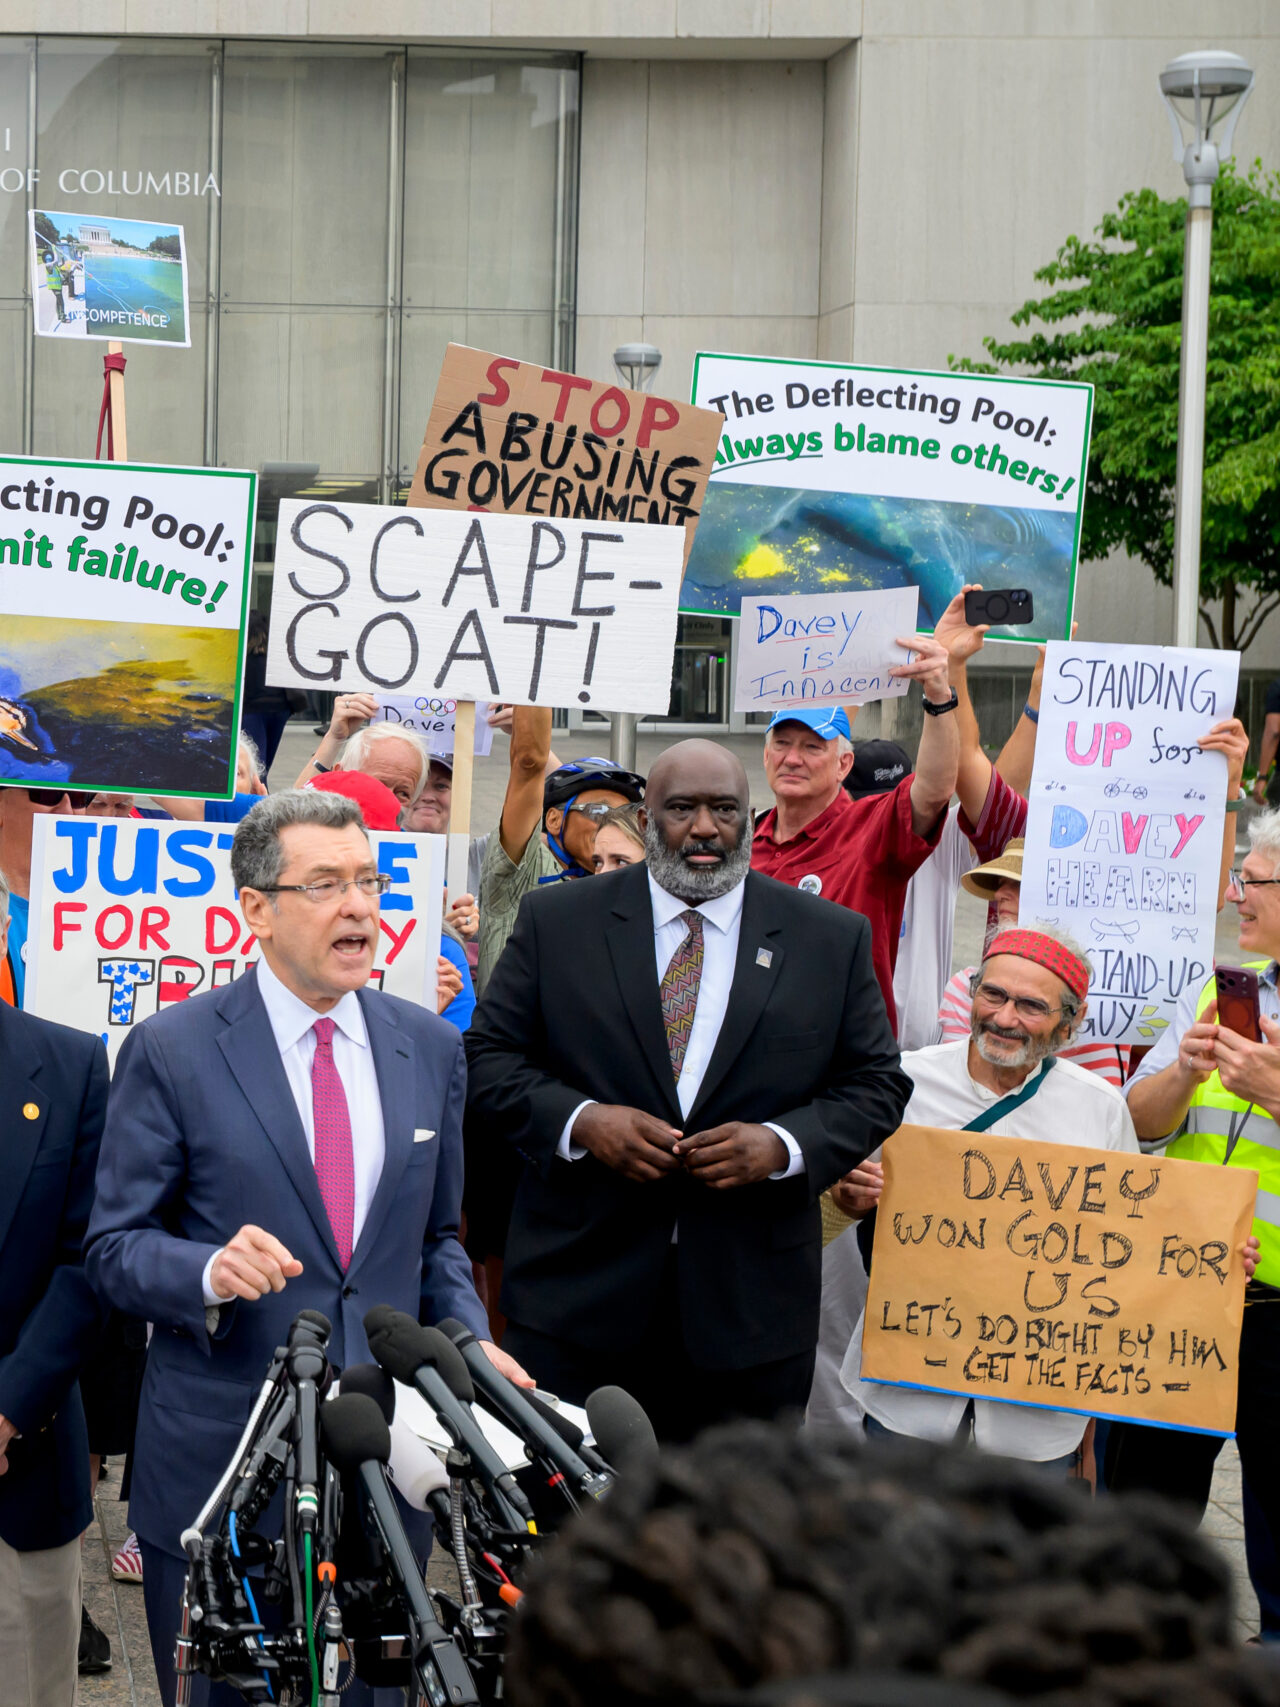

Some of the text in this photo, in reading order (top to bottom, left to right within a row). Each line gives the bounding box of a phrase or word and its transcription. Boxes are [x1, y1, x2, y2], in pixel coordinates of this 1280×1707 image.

[5, 127, 11, 151] I
[0, 168, 40, 193] OF
[58, 169, 221, 197] COLUMBIA
[477, 357, 680, 448] STOP
[708, 379, 1057, 447] The Deflecting Pool:
[834, 422, 941, 459] blame
[950, 443, 1076, 501] others!
[123, 496, 235, 564] Pool:
[67, 536, 229, 613] failure!
[288, 504, 663, 616] SCAPE-
[285, 601, 601, 703] GOAT!
[756, 605, 863, 657] Davey
[802, 647, 835, 670] is
[1053, 658, 1216, 716] STANDING
[1066, 720, 1204, 767] UP for
[1049, 804, 1205, 859] DAVEY
[1046, 858, 1196, 915] HEARN
[53, 901, 172, 952] FOR
[961, 1148, 1161, 1219] DAVEY
[893, 1209, 1230, 1285] WON GOLD FOR
[1023, 1270, 1121, 1319] US
[880, 1296, 1228, 1371] LET'S DO RIGHT BY HIM
[963, 1345, 1017, 1383] GET
[1025, 1353, 1066, 1388] THE
[1074, 1363, 1151, 1396] FACTS
